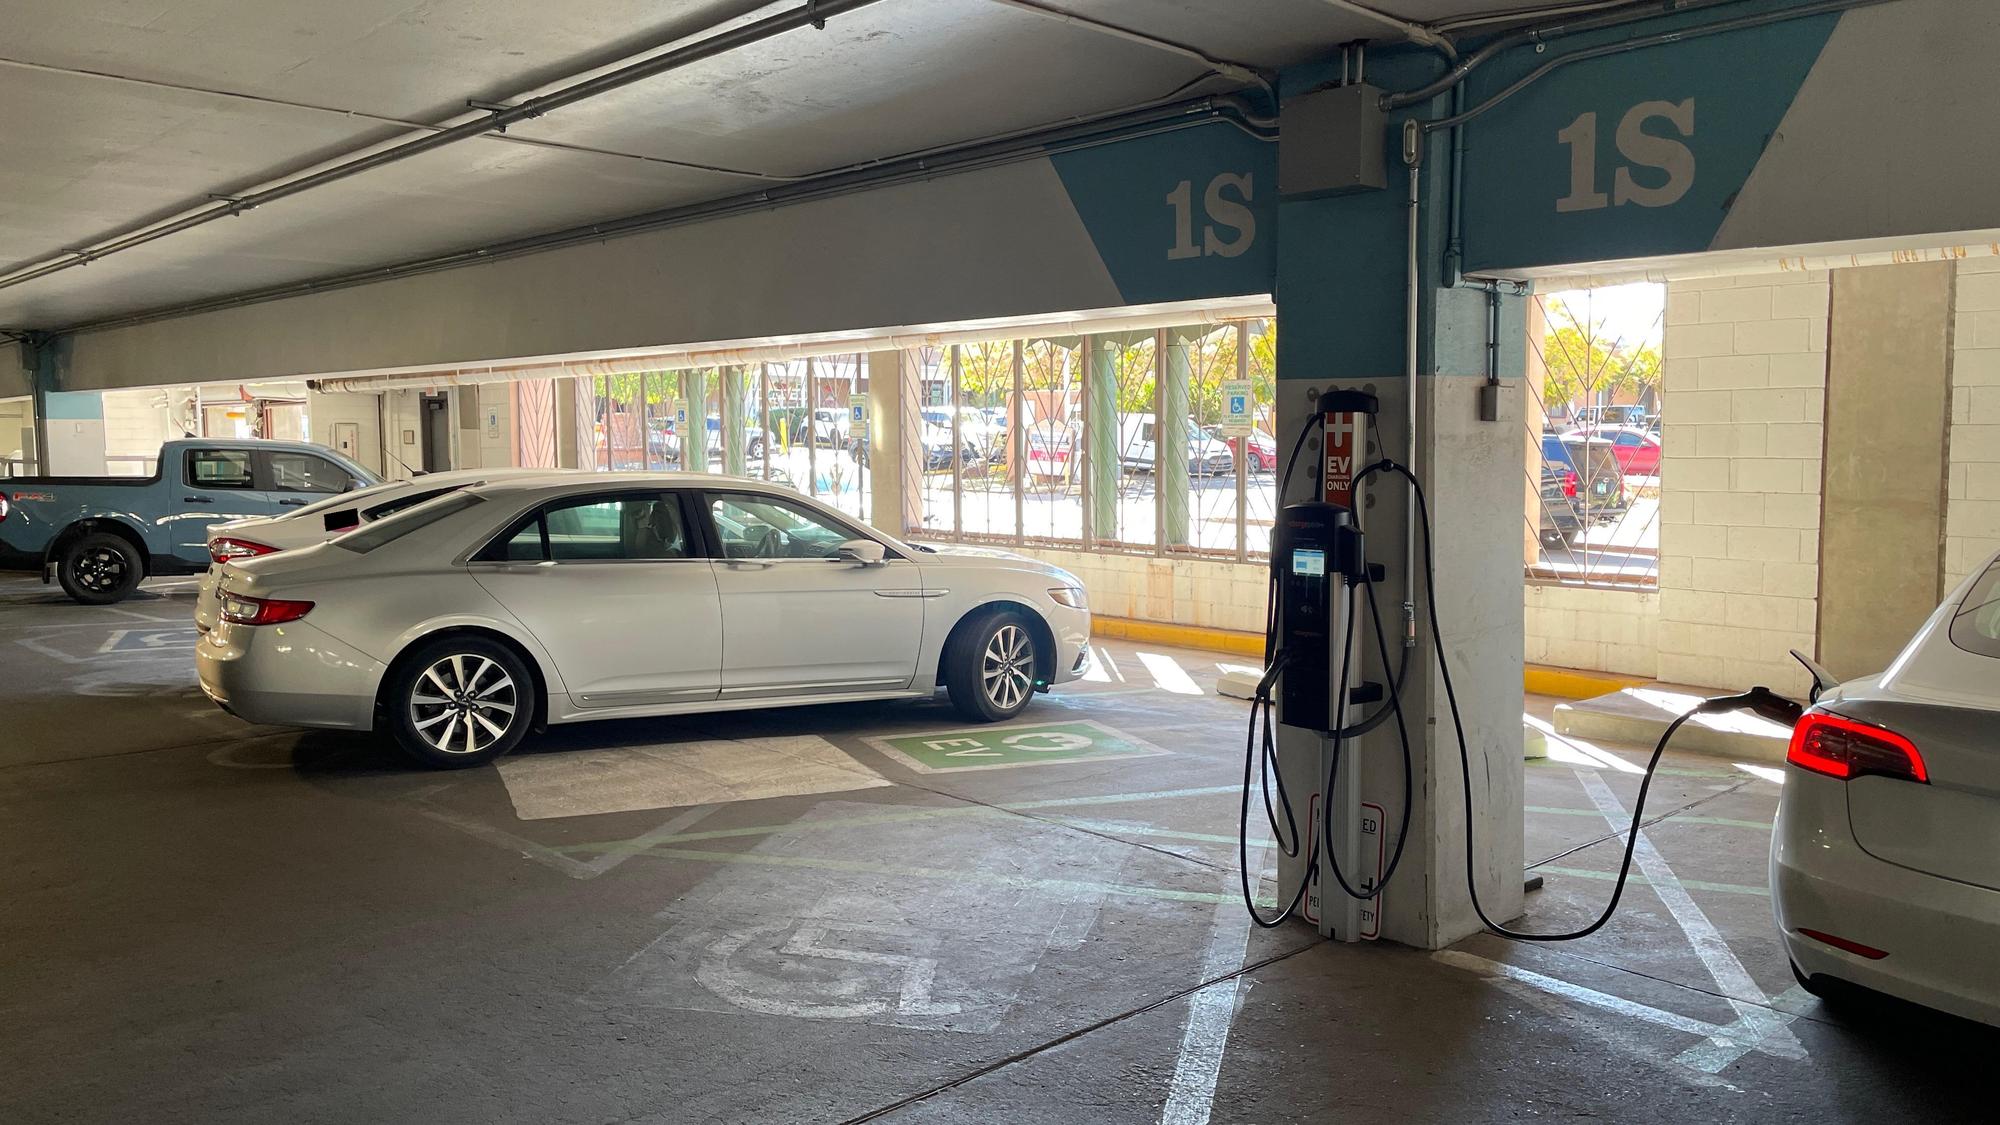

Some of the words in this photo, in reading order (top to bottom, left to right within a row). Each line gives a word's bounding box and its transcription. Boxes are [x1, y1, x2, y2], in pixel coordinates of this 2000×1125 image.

[1555, 97, 1696, 213] 1S
[1166, 172, 1256, 260] 1S
[1327, 456, 1351, 473] EV
[1327, 481, 1350, 491] ONLY
[921, 737, 1004, 757] EV
[1361, 818, 1377, 833] ED
